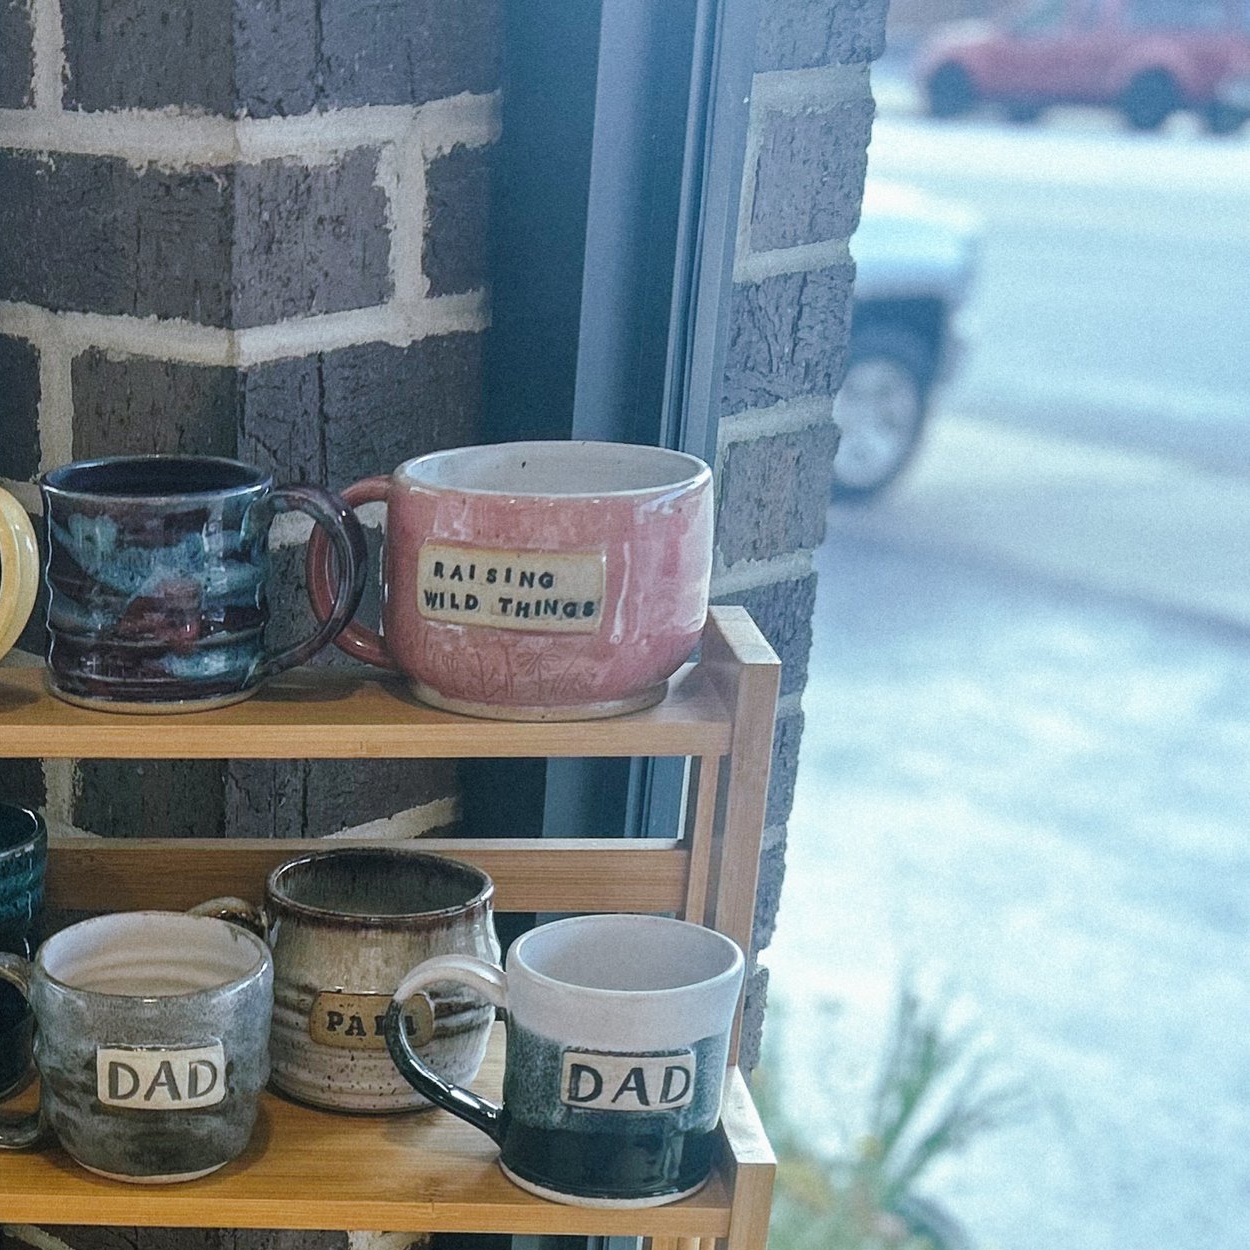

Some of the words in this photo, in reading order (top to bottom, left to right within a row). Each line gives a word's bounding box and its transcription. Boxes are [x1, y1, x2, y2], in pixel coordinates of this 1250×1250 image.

[433, 561, 554, 589] RAISING
[424, 589, 479, 611] WILD
[499, 596, 595, 618] THINGS
[108, 1060, 218, 1101] DAD
[568, 1063, 691, 1106] DAD
